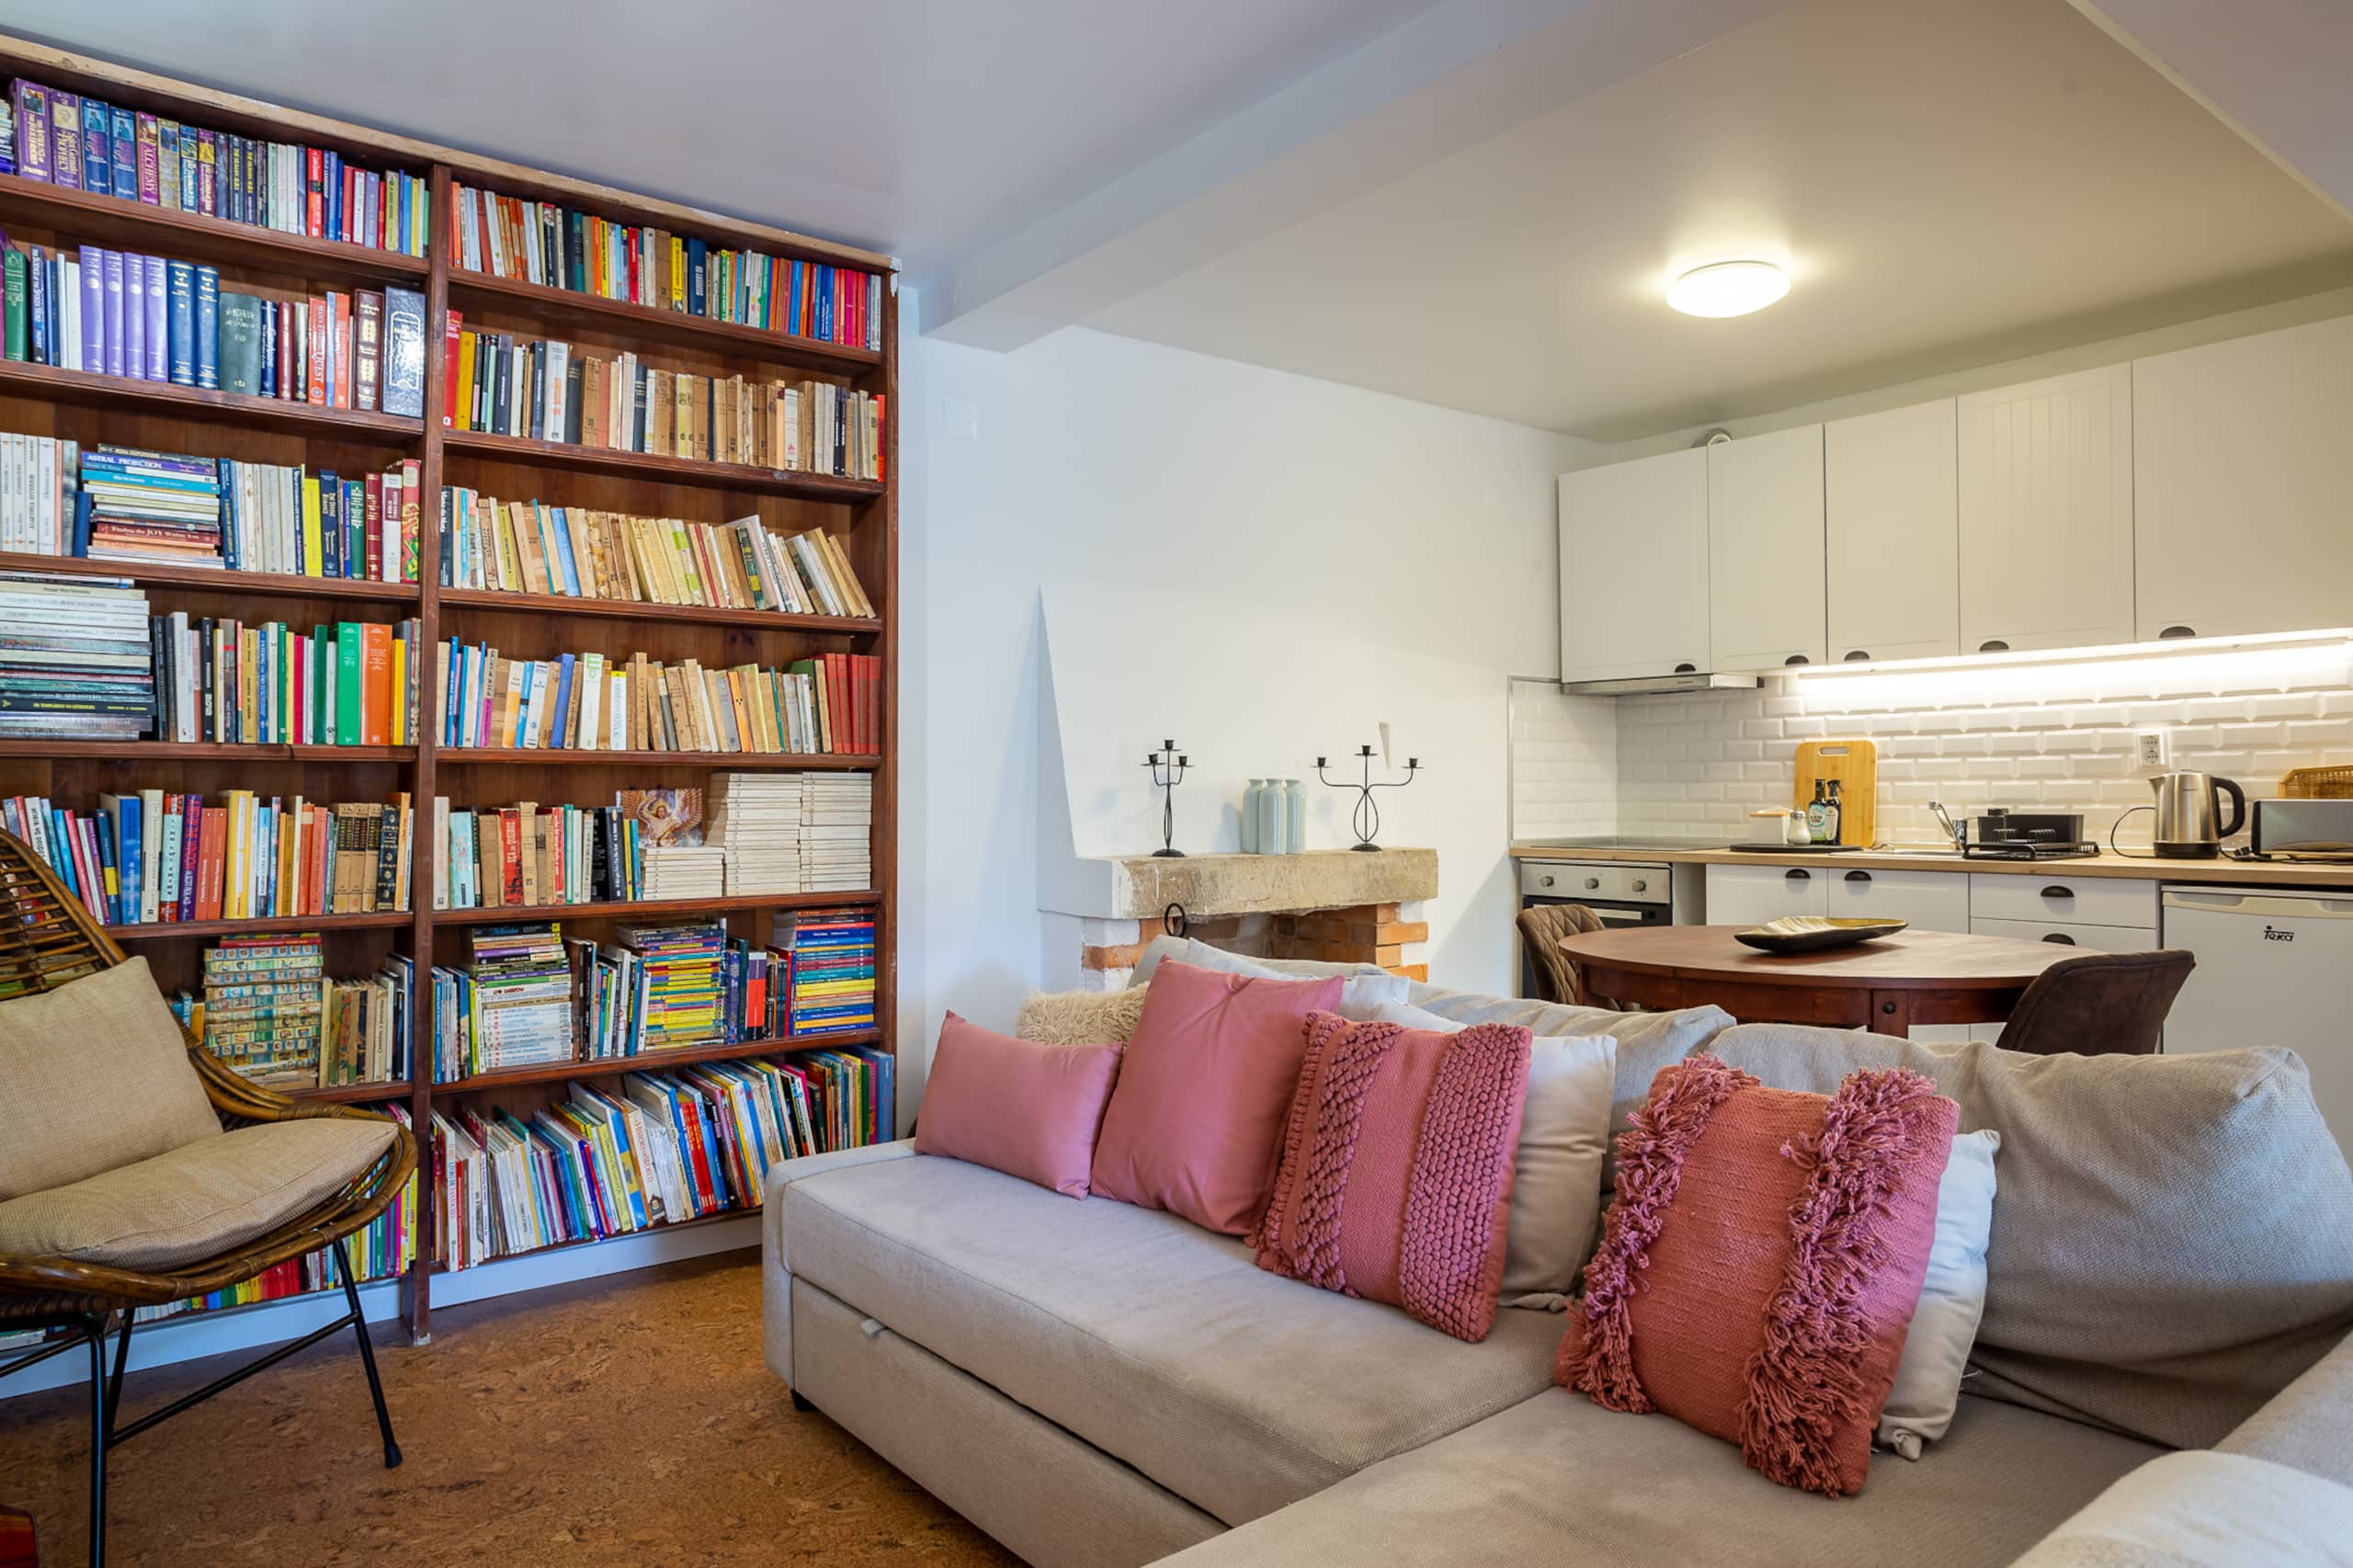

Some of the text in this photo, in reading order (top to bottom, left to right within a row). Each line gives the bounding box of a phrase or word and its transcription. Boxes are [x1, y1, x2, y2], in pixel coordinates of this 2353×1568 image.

[144, 146, 154, 193] ALCHEMY
[312, 352, 324, 382] QUEST
[87, 453, 162, 469] ASTRAL PROJECTION
[110, 526, 134, 534] Finding
[146, 528, 163, 537] JOY
[506, 852, 517, 863] EÇA
